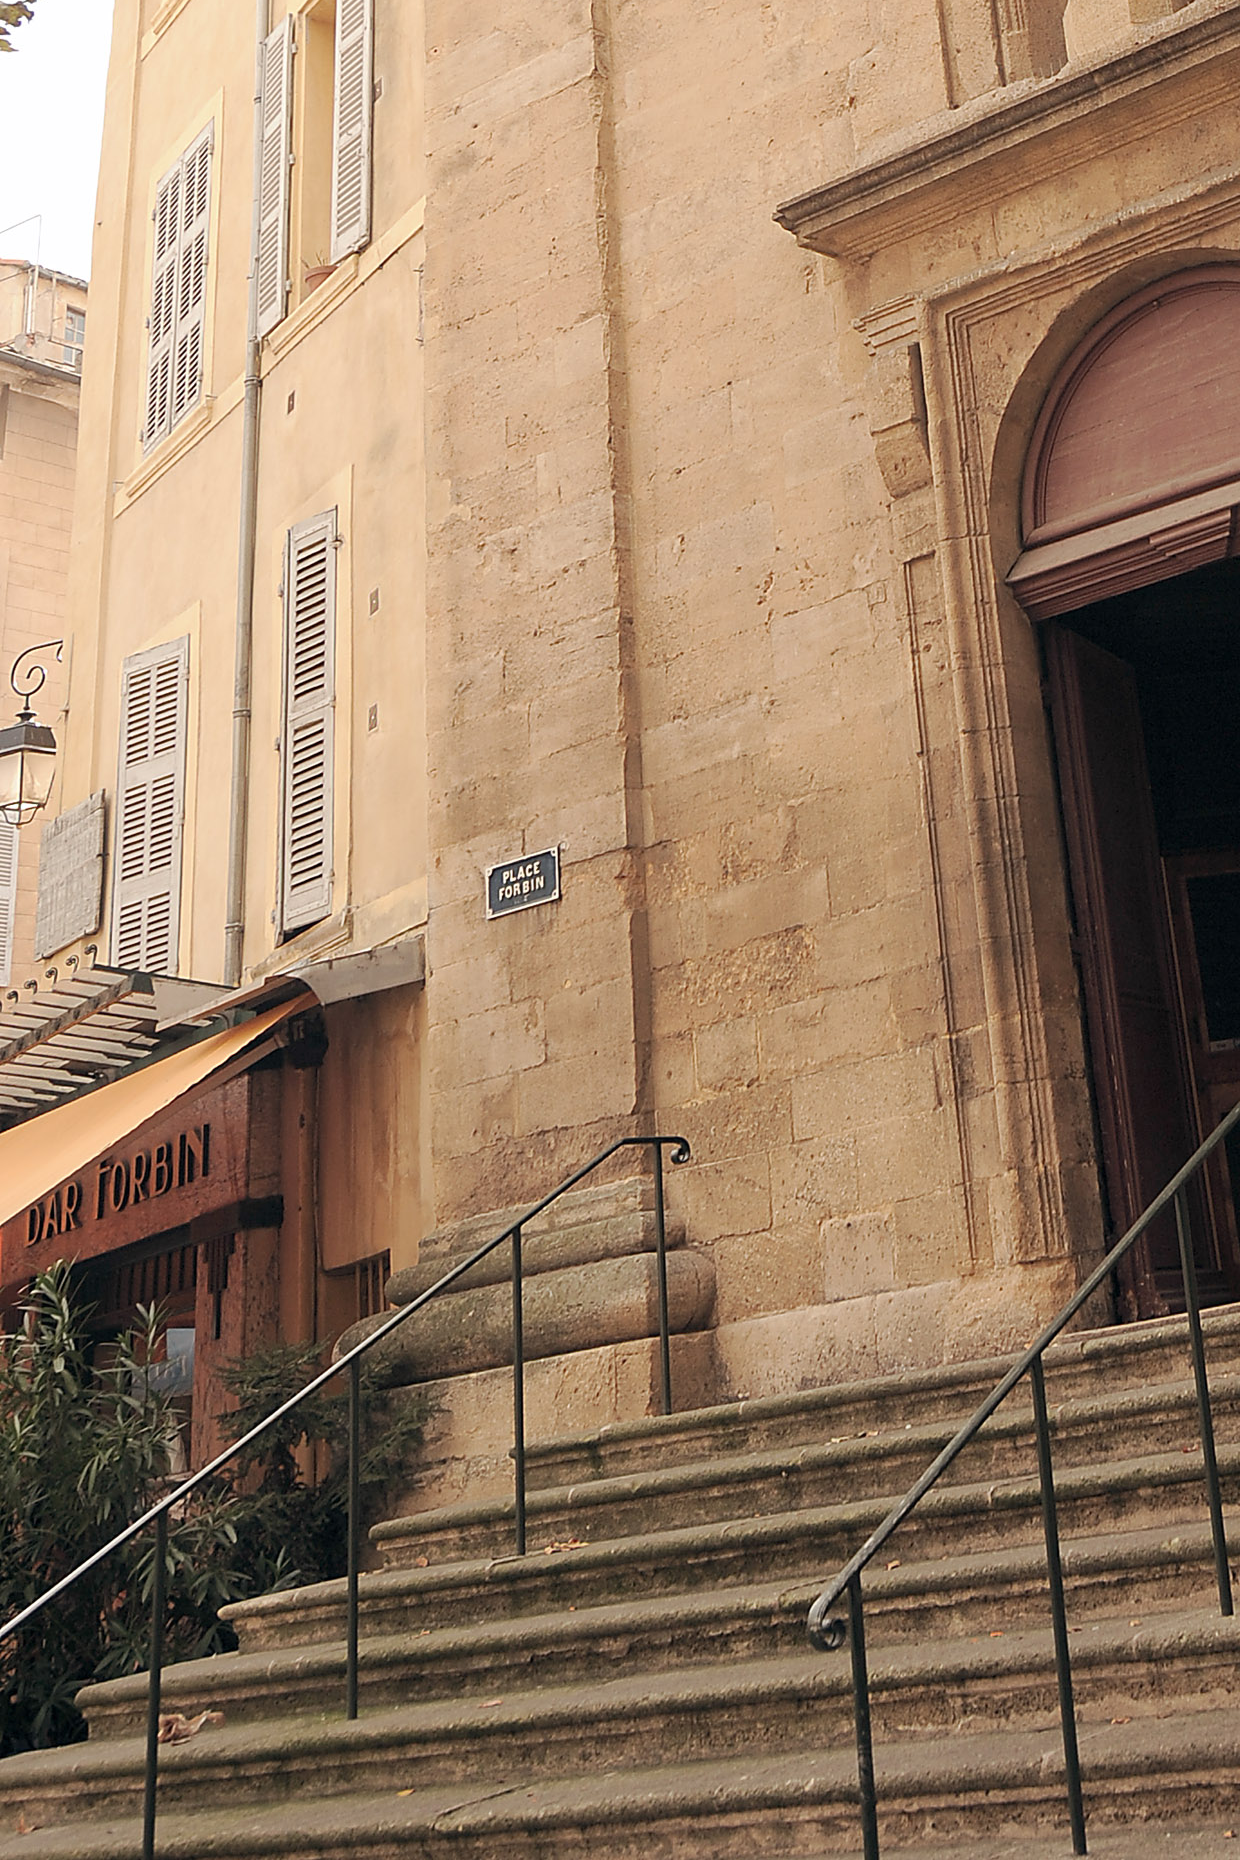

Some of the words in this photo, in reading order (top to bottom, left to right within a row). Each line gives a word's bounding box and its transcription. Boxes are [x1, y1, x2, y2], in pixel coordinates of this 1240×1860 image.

[502, 861, 541, 884] PLACE
[498, 876, 544, 902] FORBIN
[24, 1182, 79, 1248] DAR
[93, 1122, 210, 1221] FORBIN
